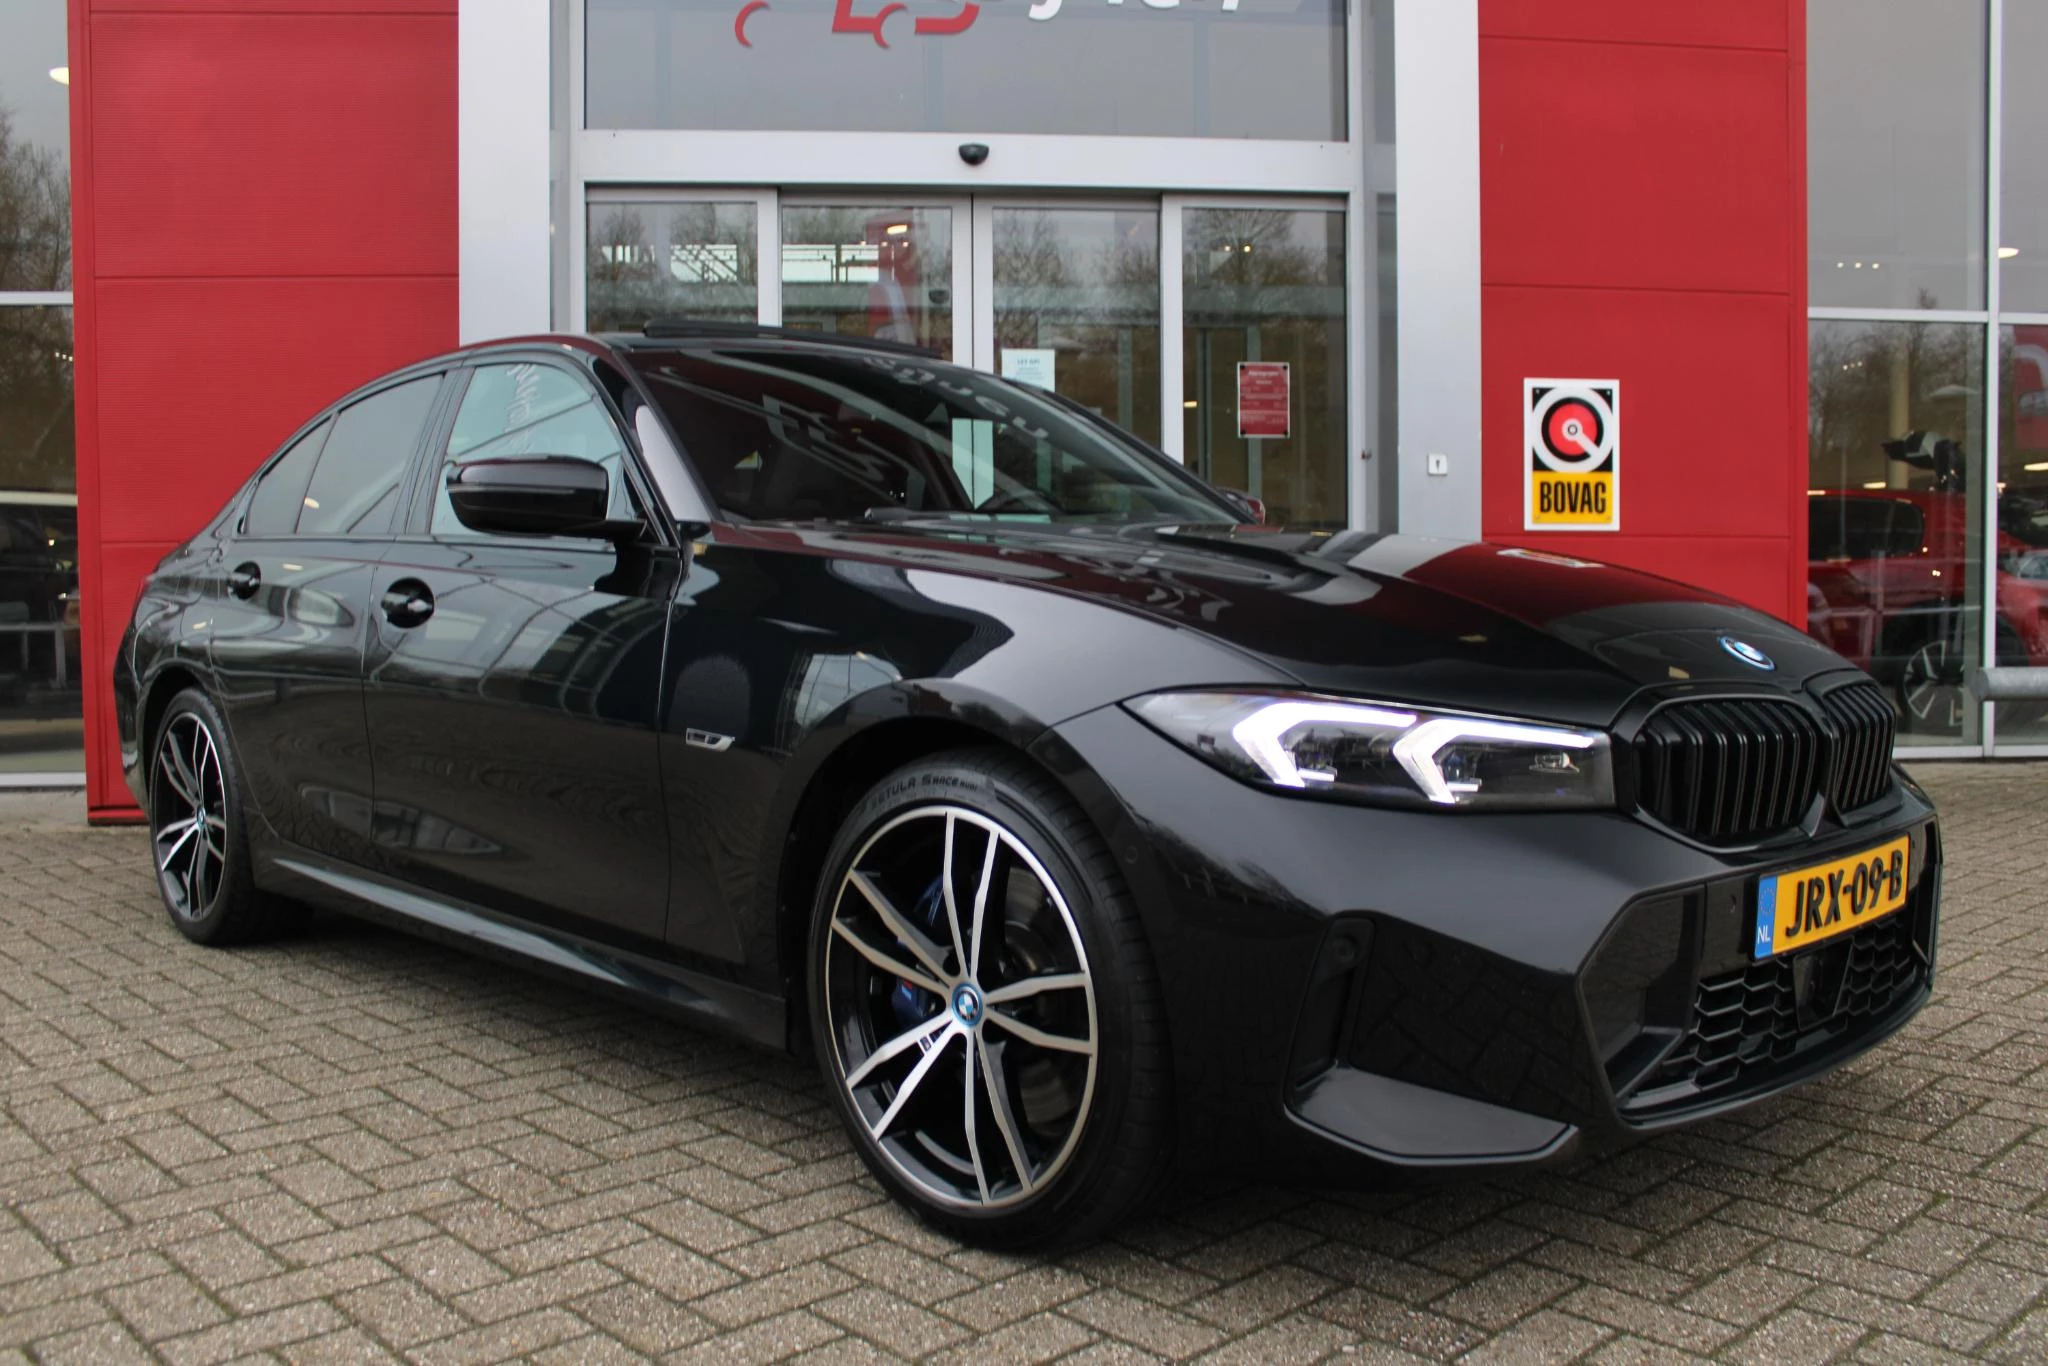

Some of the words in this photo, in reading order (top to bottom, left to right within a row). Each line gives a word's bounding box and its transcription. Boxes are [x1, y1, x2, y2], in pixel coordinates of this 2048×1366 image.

[1539, 481, 1607, 514] BOVAG
[1785, 848, 1905, 938] JRX-09-B
[1757, 925, 1771, 944] NL
